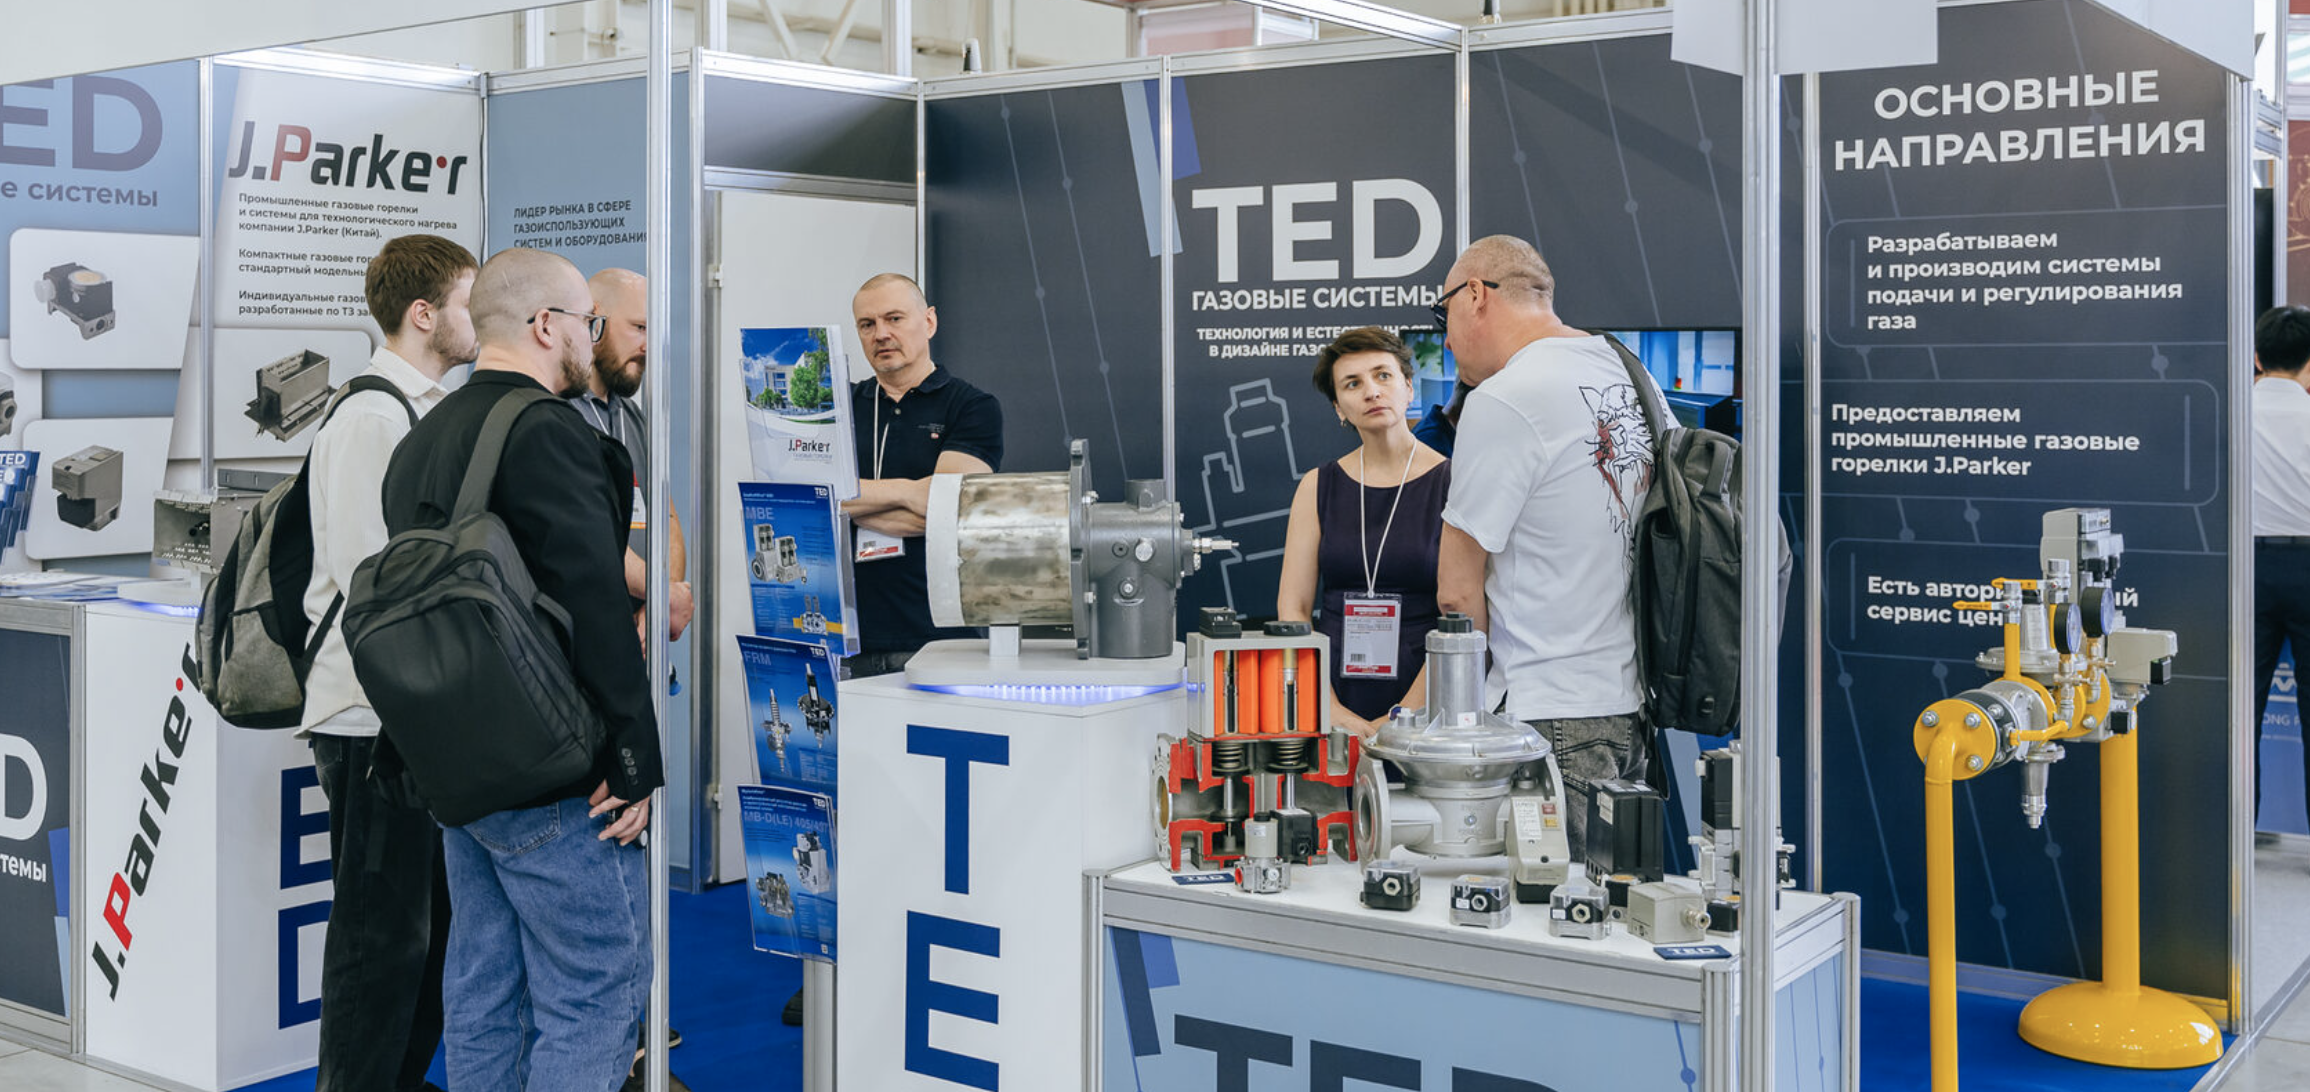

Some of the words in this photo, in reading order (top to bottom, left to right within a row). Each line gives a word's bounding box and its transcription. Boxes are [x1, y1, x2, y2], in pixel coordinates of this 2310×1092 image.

[1874, 69, 2159, 120] ОСНОВНЫЕ
[1835, 119, 2206, 172] НАПРАВЛЕНИЯ
[228, 121, 468, 195] J.Parker
[28, 183, 158, 207] системы
[239, 193, 329, 208] Промышленные
[331, 201, 374, 211] газовые
[377, 204, 419, 214] горелки
[239, 208, 246, 216] и
[249, 209, 297, 219] системы
[299, 212, 319, 221] для
[322, 213, 416, 226] технологического
[418, 220, 458, 230] нагрева
[514, 207, 547, 219] ЛИДЕР
[549, 203, 585, 215] РЫНКА
[588, 203, 594, 213] В
[597, 200, 632, 213] СФЕРЕ
[239, 222, 295, 233] компании
[297, 224, 339, 235] J.Parker
[341, 227, 382, 239] (Китай).
[514, 217, 625, 233] ГАЗОИСПОЛЬЗУЮЩИХ
[1192, 178, 1443, 283] TED
[514, 238, 552, 249] СИСТЕМ
[555, 238, 562, 248] И
[1868, 232, 2058, 254] Разрабатываем
[239, 249, 307, 261] Компактные
[310, 253, 354, 263] газовые
[239, 263, 311, 275] стандартный
[1868, 264, 1882, 278] и
[1888, 260, 2041, 280] производим
[2048, 256, 2161, 274] системы
[239, 290, 335, 303] Индивидуальные
[337, 295, 366, 303] газов
[1192, 289, 1306, 311] ГАЗОВЫЕ
[1312, 285, 1443, 308] СИСТЕМЫ
[1868, 288, 1954, 305] подачи
[1961, 287, 1976, 302] и
[1983, 283, 2183, 306] регулирования
[239, 305, 323, 315] разработанные
[326, 308, 340, 316] по
[342, 307, 355, 316] ТЗ
[1868, 314, 1917, 329] газа
[1196, 327, 1290, 340] ТЕХНОЛОГИЯ
[1292, 327, 1303, 339] И
[1209, 345, 1219, 357] В
[1221, 342, 1290, 359] ДИЗАЙНЕ
[1831, 404, 2021, 424] Предоставляем
[788, 439, 831, 452] J.Parker
[1831, 431, 2027, 450] промышленные
[2034, 435, 2140, 451] газовые
[1831, 457, 1928, 476] горелки
[1934, 457, 2031, 476] J.Parker
[745, 506, 775, 520] MBE
[1868, 576, 1920, 596] Есть
[1867, 603, 1952, 624] сервис
[1958, 610, 2004, 627] цен
[92, 642, 201, 1001] J.Parker
